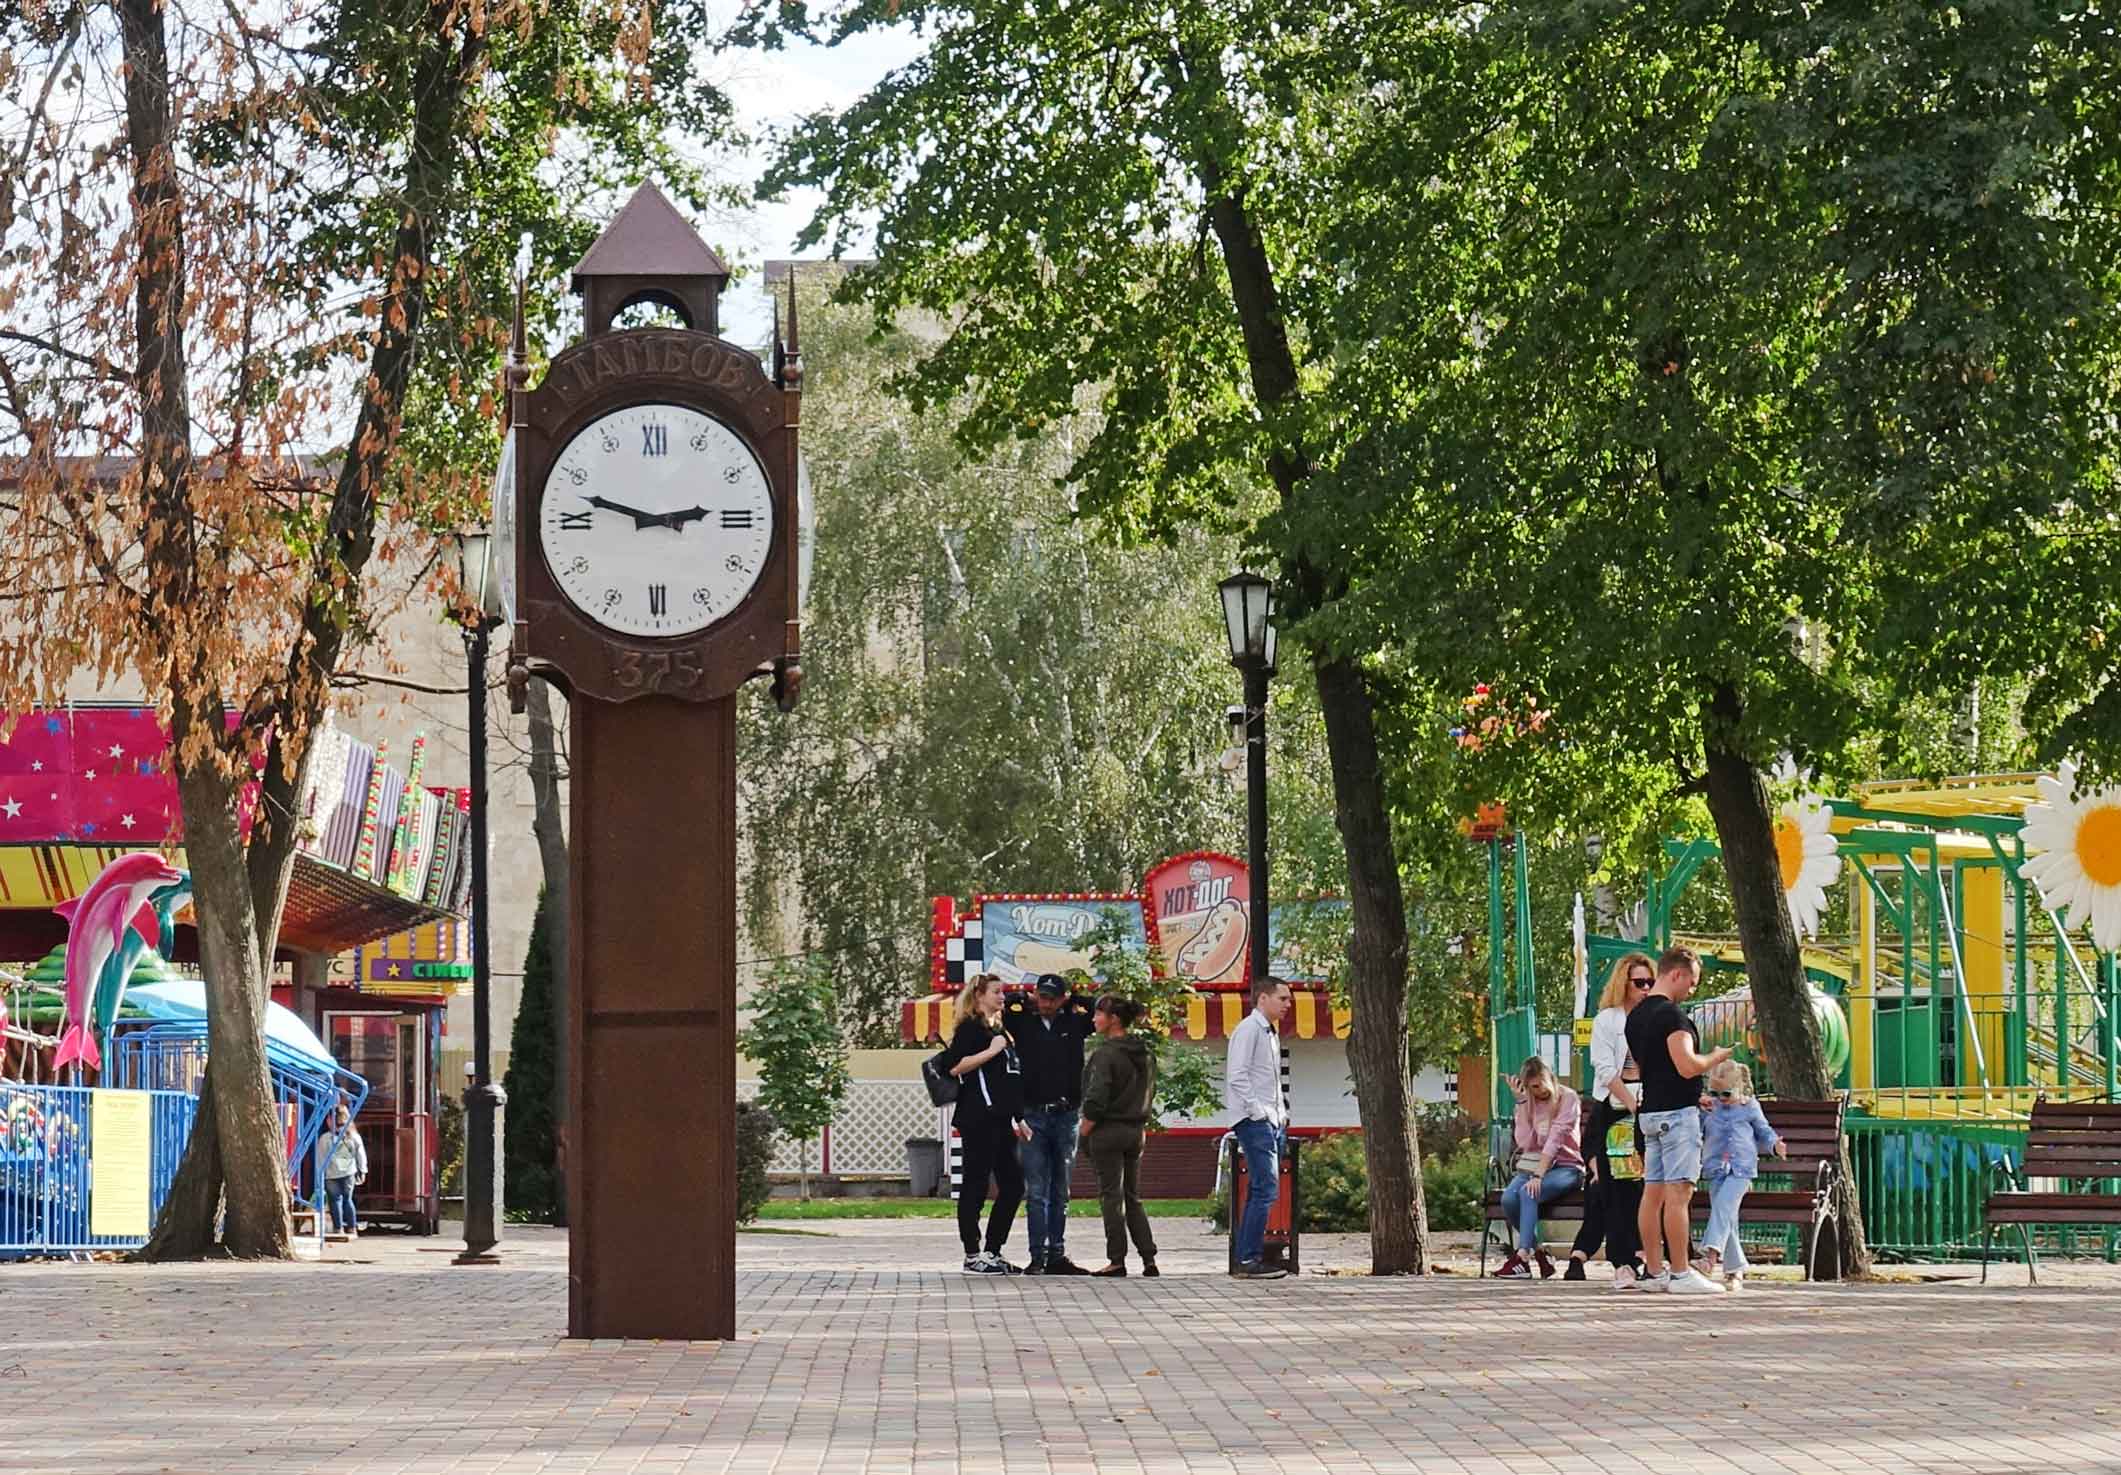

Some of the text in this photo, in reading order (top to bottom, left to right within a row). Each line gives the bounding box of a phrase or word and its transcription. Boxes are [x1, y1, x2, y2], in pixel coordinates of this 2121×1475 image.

[560, 336, 747, 387] ТАМБОВ
[641, 423, 667, 457] XII
[648, 583, 666, 617] VI
[620, 650, 699, 691] 375
[1011, 904, 1096, 939] Хот-Д
